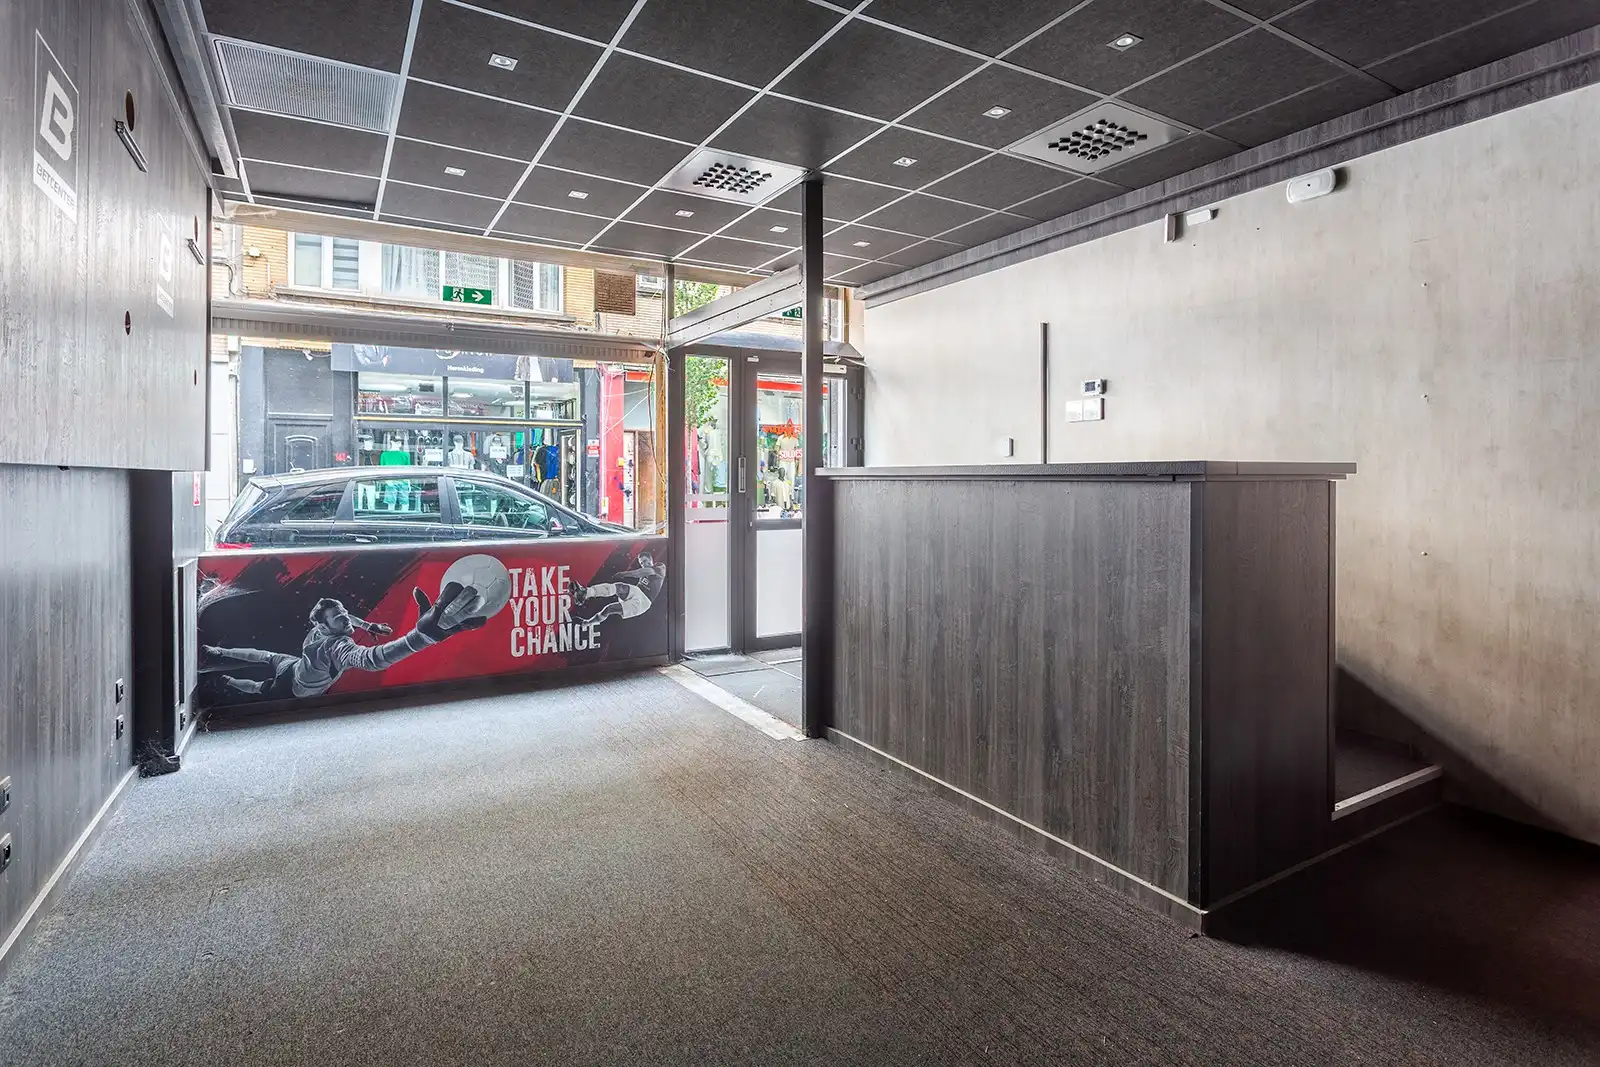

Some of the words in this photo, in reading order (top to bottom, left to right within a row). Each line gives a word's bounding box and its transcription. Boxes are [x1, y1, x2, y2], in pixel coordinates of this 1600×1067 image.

[40, 70, 74, 161] B
[36, 162, 76, 210] BETCENTER
[508, 565, 570, 598] TAKE
[509, 594, 573, 628] YOUR
[510, 622, 601, 658] CHANCE
